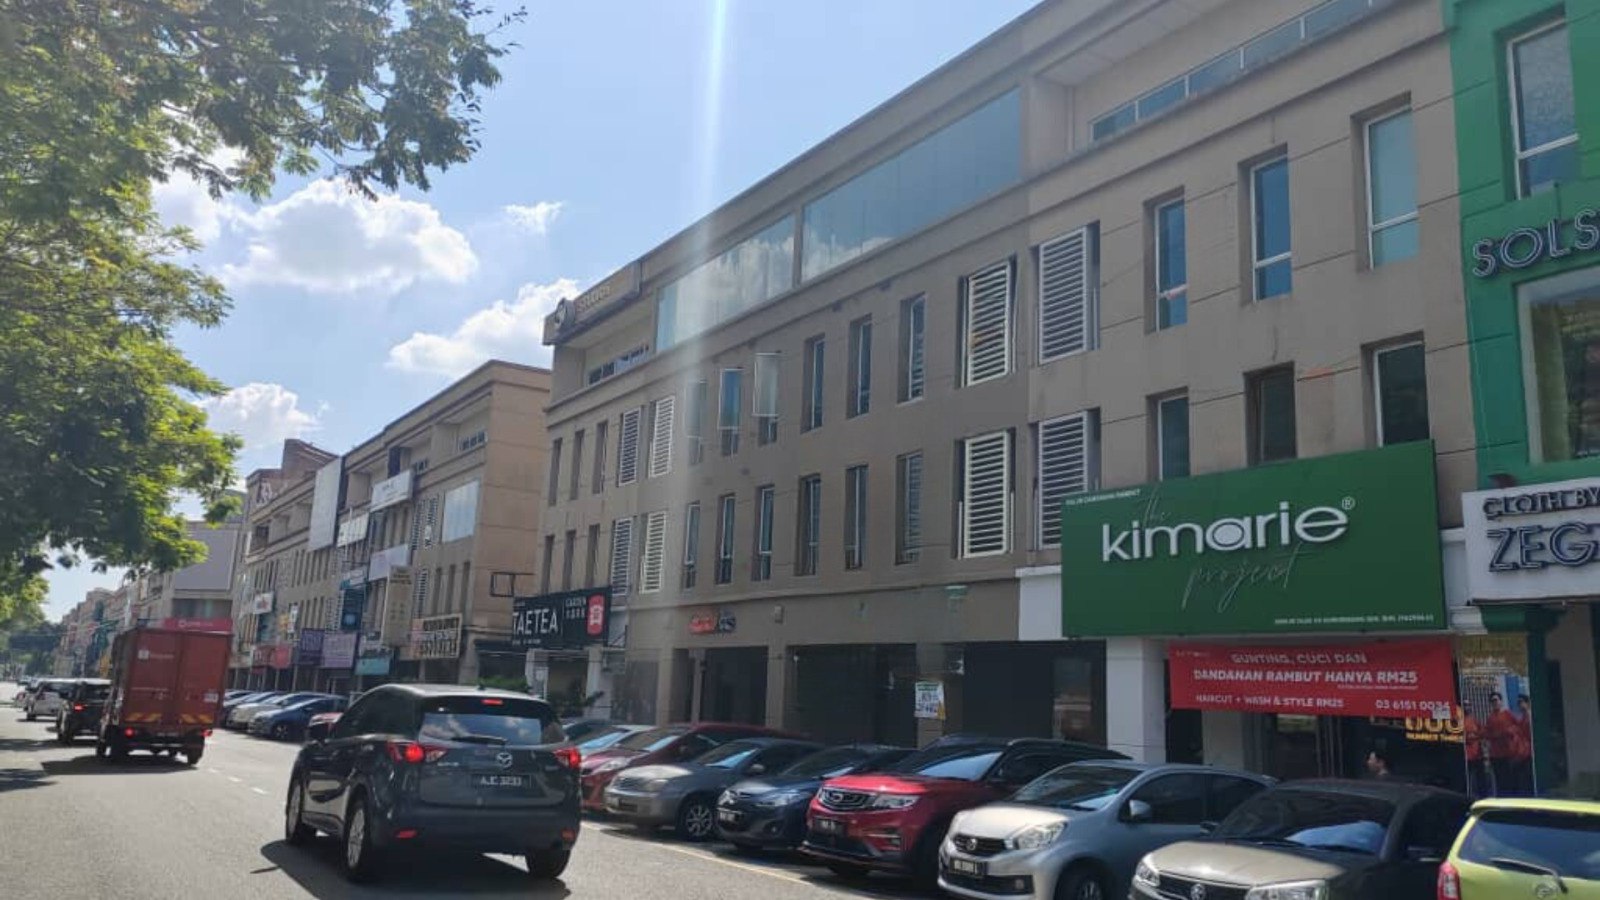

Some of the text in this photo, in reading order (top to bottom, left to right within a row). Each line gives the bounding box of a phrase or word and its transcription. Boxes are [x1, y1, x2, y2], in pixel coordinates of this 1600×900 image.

[1472, 208, 1600, 277] SOLS
[1483, 491, 1563, 518] CLOTH
[1102, 501, 1349, 562] kimarie
[1486, 522, 1598, 572] ZEG
[1181, 541, 1318, 613] project
[512, 608, 559, 635] TAETEA
[1297, 653, 1331, 664] CUCI
[1334, 653, 1367, 664] DAN
[1193, 669, 1418, 684] DANDANAN RAMBUT HANYA RM25
[1195, 694, 1233, 704] HAIRCUT
[1281, 696, 1314, 707] STYLE
[1375, 699, 1390, 709] 03
